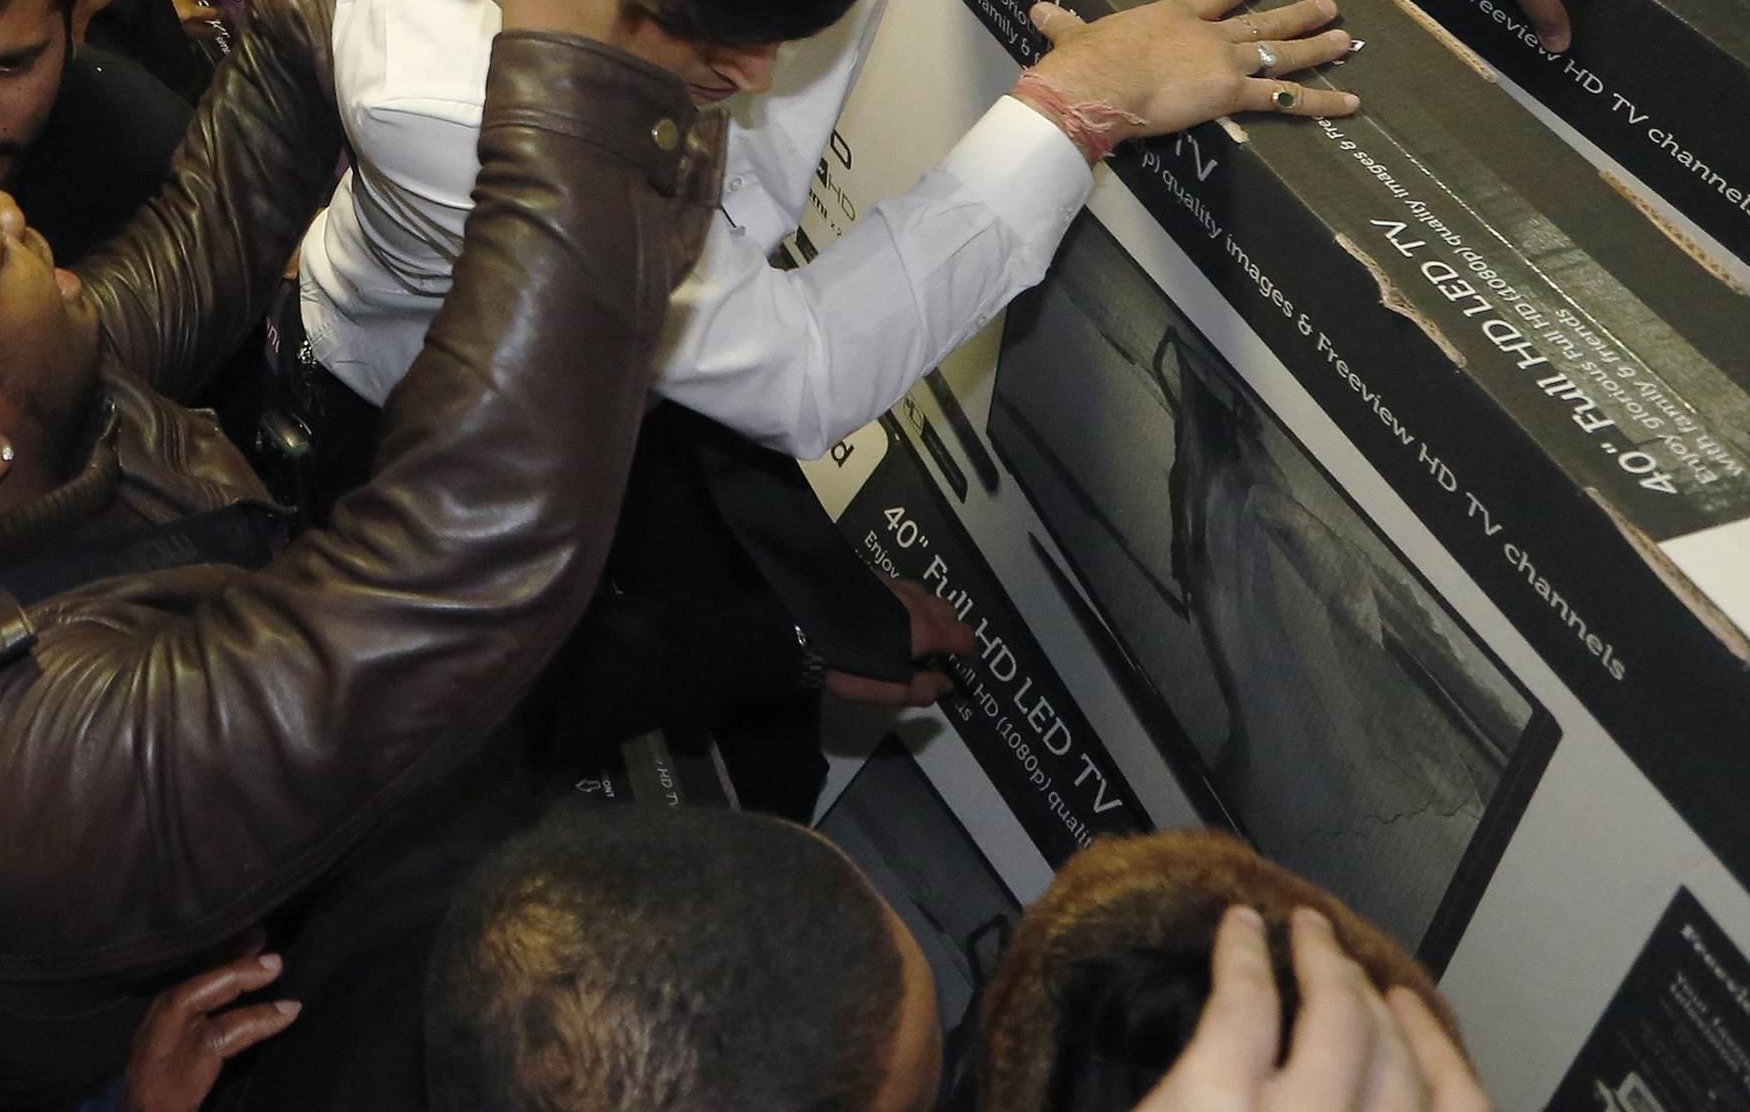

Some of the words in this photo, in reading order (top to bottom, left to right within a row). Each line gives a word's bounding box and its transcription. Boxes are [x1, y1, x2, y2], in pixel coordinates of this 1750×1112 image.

[1021, 38, 1031, 56] &
[1563, 57, 1604, 95] HD
[1611, 93, 1649, 125] TV
[1340, 139, 1356, 151] &
[1353, 150, 1412, 200] images
[1369, 217, 1426, 259] TV
[1404, 199, 1463, 246] quality
[1419, 260, 1496, 319] LED
[1453, 245, 1526, 303] (1080p)
[1513, 302, 1550, 331] HD
[1556, 307, 1621, 363] friends
[1481, 318, 1548, 371] HD
[1543, 328, 1583, 361] Full
[1617, 364, 1635, 377] &
[1537, 373, 1614, 435] Full
[1581, 356, 1662, 431] glorious
[1633, 380, 1700, 432] family
[1162, 167, 1223, 241] quality
[1224, 232, 1294, 320] images
[1297, 314, 1313, 336] &
[1316, 330, 1414, 446] Freeview
[1418, 441, 1458, 494] HD
[1465, 491, 1503, 538] TV
[1503, 542, 1627, 683] channels
[1601, 444, 1678, 495] 40"
[883, 505, 930, 549] 40"
[922, 554, 974, 622] Full
[975, 617, 1017, 683] HD
[1013, 677, 1072, 757] LED
[1072, 753, 1123, 816] TV
[973, 682, 1001, 718] HD
[995, 715, 1053, 794] (1080p)
